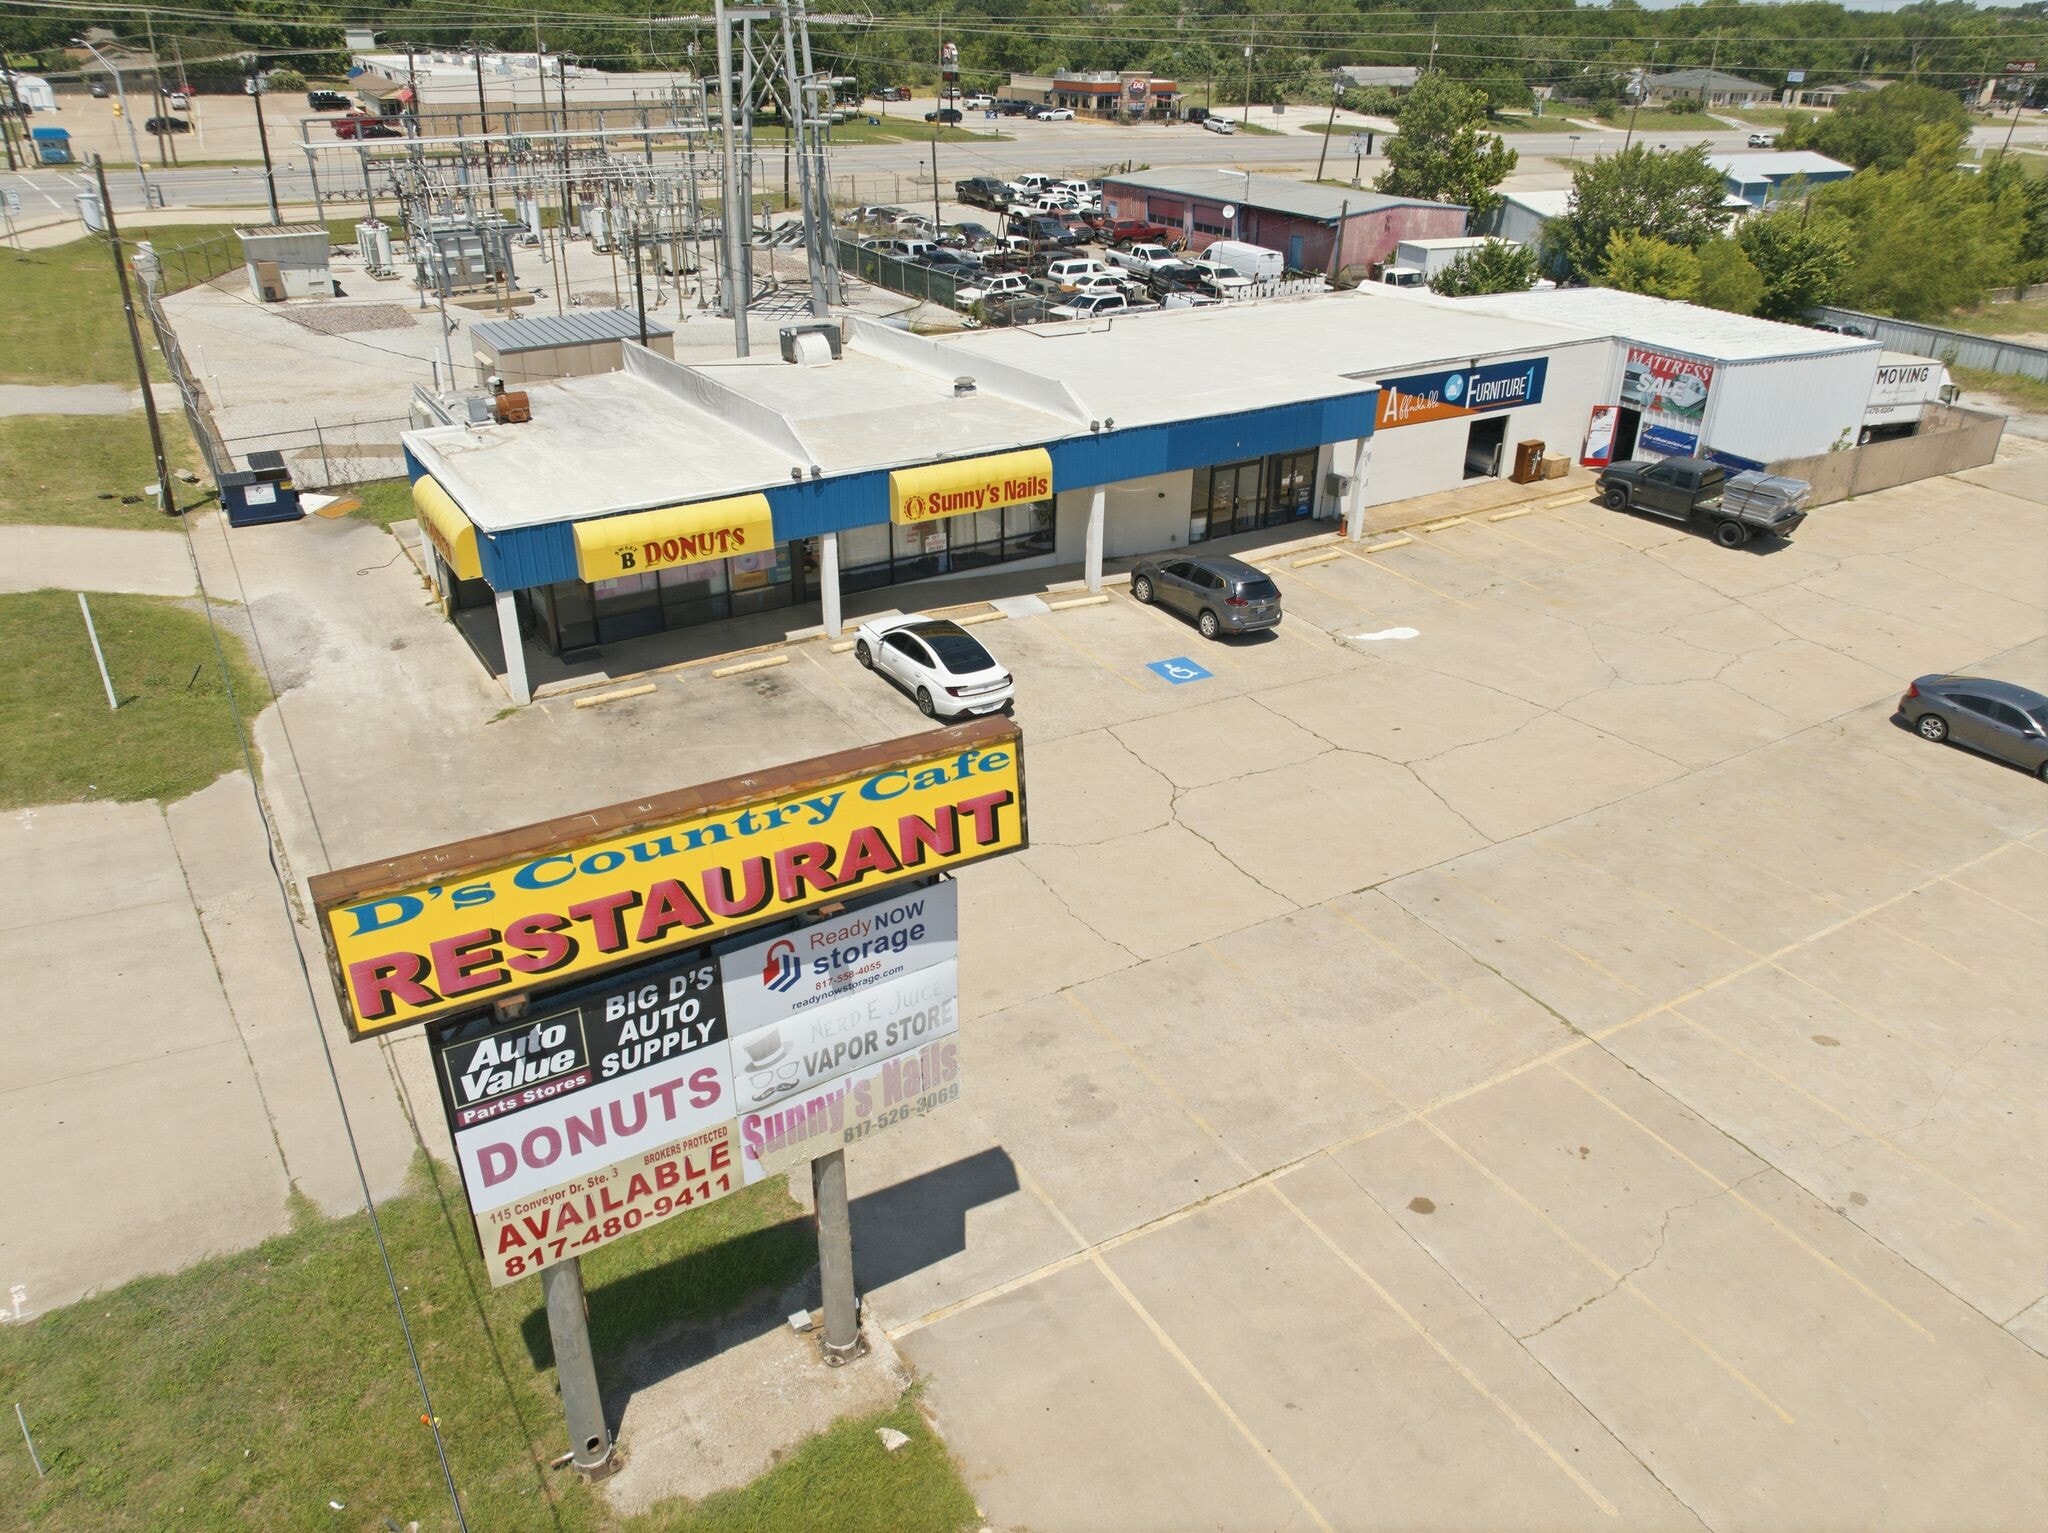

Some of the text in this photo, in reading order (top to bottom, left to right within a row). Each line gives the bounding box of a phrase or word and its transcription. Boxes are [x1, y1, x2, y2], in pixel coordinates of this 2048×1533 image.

[1630, 350, 1712, 382] MATTRESS
[1636, 372, 1687, 400] SALE
[1876, 366, 1929, 385] MOVING
[928, 475, 1048, 515] Sunny's Nails
[621, 527, 746, 570] B DONUTS
[343, 750, 1011, 938] D's Country Cafe
[348, 788, 1015, 1021] RESTAURANT
[809, 900, 925, 950] Ready NOW
[813, 922, 926, 975] storage
[605, 965, 715, 1023] BIG D'S
[792, 963, 905, 1011] readynowstorage.com
[814, 960, 883, 991] 817-558-4055
[466, 1022, 567, 1075] Auto
[601, 1017, 717, 1078] SUPPLY
[618, 998, 700, 1047] AUTO
[802, 998, 954, 1077] VAPOR STORE
[460, 1048, 576, 1103] Value
[462, 1072, 587, 1125] Parts Stores
[742, 1041, 958, 1161] Sunny's Nails
[475, 1066, 722, 1189] DONUTS
[843, 1082, 959, 1144] 817-526-3069
[643, 1125, 728, 1166] BROKERS PROTECTED
[489, 1167, 619, 1225] 115 Conveyor Dr. Ste. 3
[497, 1139, 732, 1256] AVAILABLE
[504, 1172, 731, 1278] 817-480-9411
